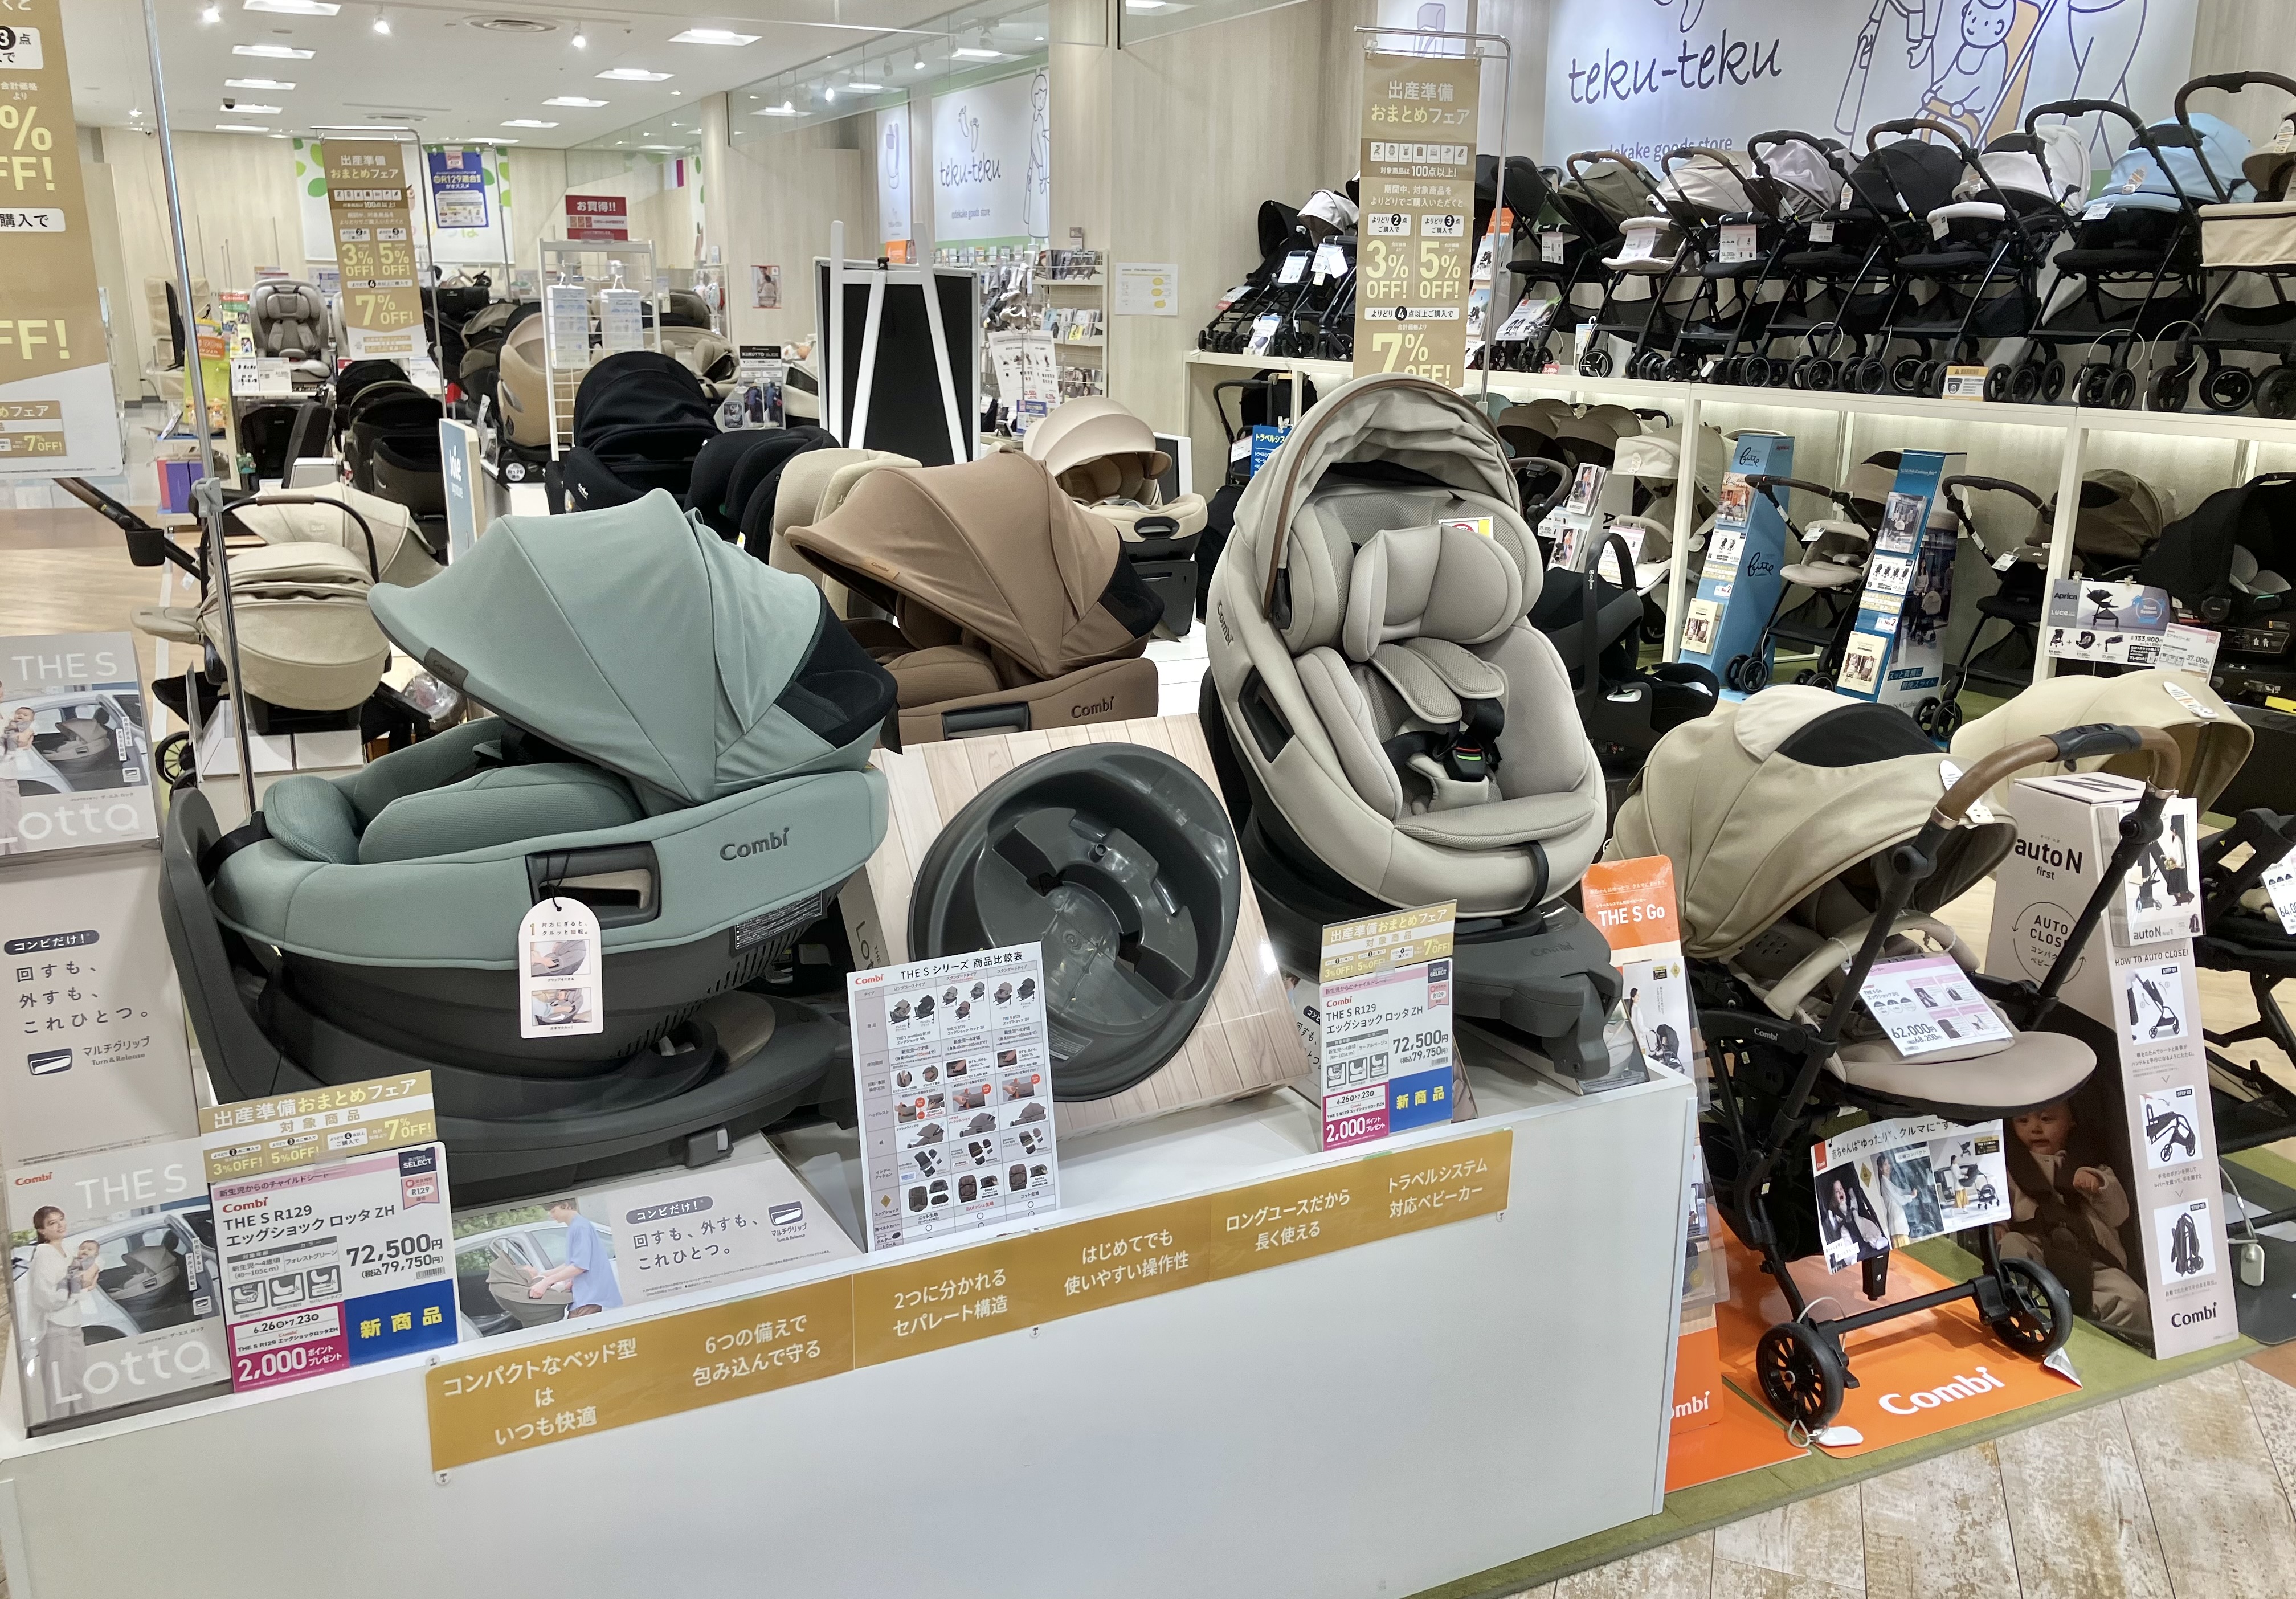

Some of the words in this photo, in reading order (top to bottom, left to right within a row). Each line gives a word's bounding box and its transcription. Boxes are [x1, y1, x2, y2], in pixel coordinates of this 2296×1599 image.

[1568, 28, 1782, 104] teku-teku
[1388, 80, 1453, 101] 出産準備
[1371, 104, 1470, 125] おまとめフェア
[330, 169, 398, 179] おまとめフェア
[941, 152, 1001, 187] teku-teku
[1380, 166, 1410, 175] 対象商品は
[1412, 165, 1457, 178] 100点以上!
[1384, 184, 1452, 195] 期間中、対象商品を
[1371, 196, 1464, 208] よりどりでご購入いただくと
[0, 214, 49, 227] 購入で
[969, 208, 979, 220] goods
[342, 244, 373, 265] 3%
[379, 243, 410, 264] 5%
[1366, 240, 1408, 278] 3%
[1420, 241, 1461, 279] 5%
[346, 265, 374, 277] OFF!
[382, 264, 410, 276] OFF!
[1367, 280, 1407, 298] OFF!
[1419, 281, 1459, 298] OFF!
[355, 295, 395, 326] 7%
[380, 311, 414, 324] OFF!
[1371, 306, 1453, 320] よりどり4点以上ご購入で
[38, 442, 62, 451] OFF!
[871, 561, 889, 572] Combi
[1217, 602, 1232, 645] Combi
[11, 653, 88, 681] THE
[96, 651, 118, 677] S
[1072, 696, 1114, 718] Combi
[720, 828, 790, 861] Combi
[2036, 866, 2055, 880] first
[1331, 909, 1447, 943] 出産準備おまとめフェア
[1598, 910, 1628, 927] THE
[1633, 910, 1643, 922] S
[1647, 904, 1665, 918] Go
[2034, 915, 2069, 935] AUTO
[14, 933, 87, 951] コンビだけ！
[1366, 931, 1412, 947] 対象商品
[901, 967, 921, 980] THE
[924, 967, 929, 976] S
[933, 959, 969, 975] シリーズ
[973, 951, 1023, 968] 商品比較表
[1325, 965, 1353, 978] 3%OFF!
[1432, 943, 1450, 954] OFF!
[2115, 958, 2132, 967] HOW
[2133, 955, 2143, 964] TO
[2144, 953, 2163, 963] AUTO
[2165, 948, 2189, 959] CLOSE!
[16, 960, 97, 983] 回すも、
[855, 974, 884, 985] Combi
[893, 982, 926, 991] ロングユースタイプ
[946, 971, 978, 981] スタンダードタイプ
[997, 964, 1028, 974] スタンダードタイプ
[19, 987, 99, 1009] 外すも、
[1326, 980, 1389, 995] 新生児からのチャイルドシート
[1326, 996, 1353, 1007] Combi
[1326, 1009, 1344, 1021] THE
[1347, 1008, 1352, 1017] S
[1355, 1003, 1376, 1015] R129
[23, 1005, 149, 1034] これひとつ。
[1327, 1013, 1383, 1034] エッグショック
[1386, 1008, 1410, 1021] ロッタ
[1412, 1005, 1423, 1016] ZH
[1891, 1023, 1937, 1038] 62,000円
[1393, 1029, 1449, 1054] 72,500円
[1754, 1028, 1778, 1041] Combi
[83, 1036, 150, 1057] マルチグリップ
[214, 1078, 416, 1129] 出産準備おまとめフェア
[1396, 1086, 1445, 1110] 新商品
[280, 1109, 361, 1133] 対象商品
[385, 1117, 410, 1140] 7%
[401, 1120, 431, 1138] OFF!
[1326, 1117, 1366, 1143] 2,000
[1366, 1115, 1381, 1125] ポイント
[1366, 1122, 1386, 1133] プレゼント
[336, 1139, 359, 1147] ご購入で
[213, 1158, 263, 1175] 3%OFF!
[271, 1147, 320, 1164] 5%OFF!
[403, 1158, 432, 1169] SELECT
[15, 1171, 54, 1186] Combi
[219, 1173, 329, 1197] 新生児からのチャイルドシート
[1387, 1158, 1489, 1192] トラベルシステム
[75, 1169, 157, 1210] THE
[164, 1164, 187, 1193] S
[411, 1187, 430, 1196] R129
[223, 1197, 268, 1213] Combi
[636, 1200, 700, 1221] コンビだけ！
[875, 1208, 899, 1216] エッグショック
[1225, 1188, 1351, 1232] ロングユースだから
[1389, 1184, 1484, 1219] 対応ベビーカー
[223, 1215, 256, 1231] THE
[260, 1213, 270, 1224] S
[275, 1205, 312, 1221] R129
[227, 1218, 325, 1247] エッグショック
[330, 1209, 371, 1228] ロッタ
[375, 1205, 395, 1218] ZH
[633, 1214, 758, 1250] 回すも、外すも、
[771, 1223, 807, 1237] マルチグリップ
[1255, 1220, 1321, 1253] 長く使える
[285, 1250, 338, 1265] フォレストグリーン
[346, 1234, 443, 1267] 72,500円
[638, 1244, 733, 1271] これひとつ。
[1081, 1229, 1174, 1265] はじめてでも
[1064, 1250, 1190, 1296] 使いやすい操作性
[894, 1267, 1007, 1310] 2つに分かれる
[360, 1306, 443, 1338] 新商品
[893, 1295, 1008, 1336] セパレート構造
[2171, 1302, 2217, 1328] Combi
[705, 1315, 807, 1355] 6つの備えで
[308, 1345, 334, 1356] ポイント
[309, 1352, 342, 1367] プレゼント
[54, 1340, 211, 1405] Lotta
[238, 1347, 307, 1383] 2,000
[442, 1336, 638, 1397] コンパクトなベッド型
[692, 1340, 822, 1387] 包み込んで守る
[535, 1387, 555, 1406] は
[1878, 1366, 2005, 1416] Combi
[495, 1405, 598, 1446] いつも快適
